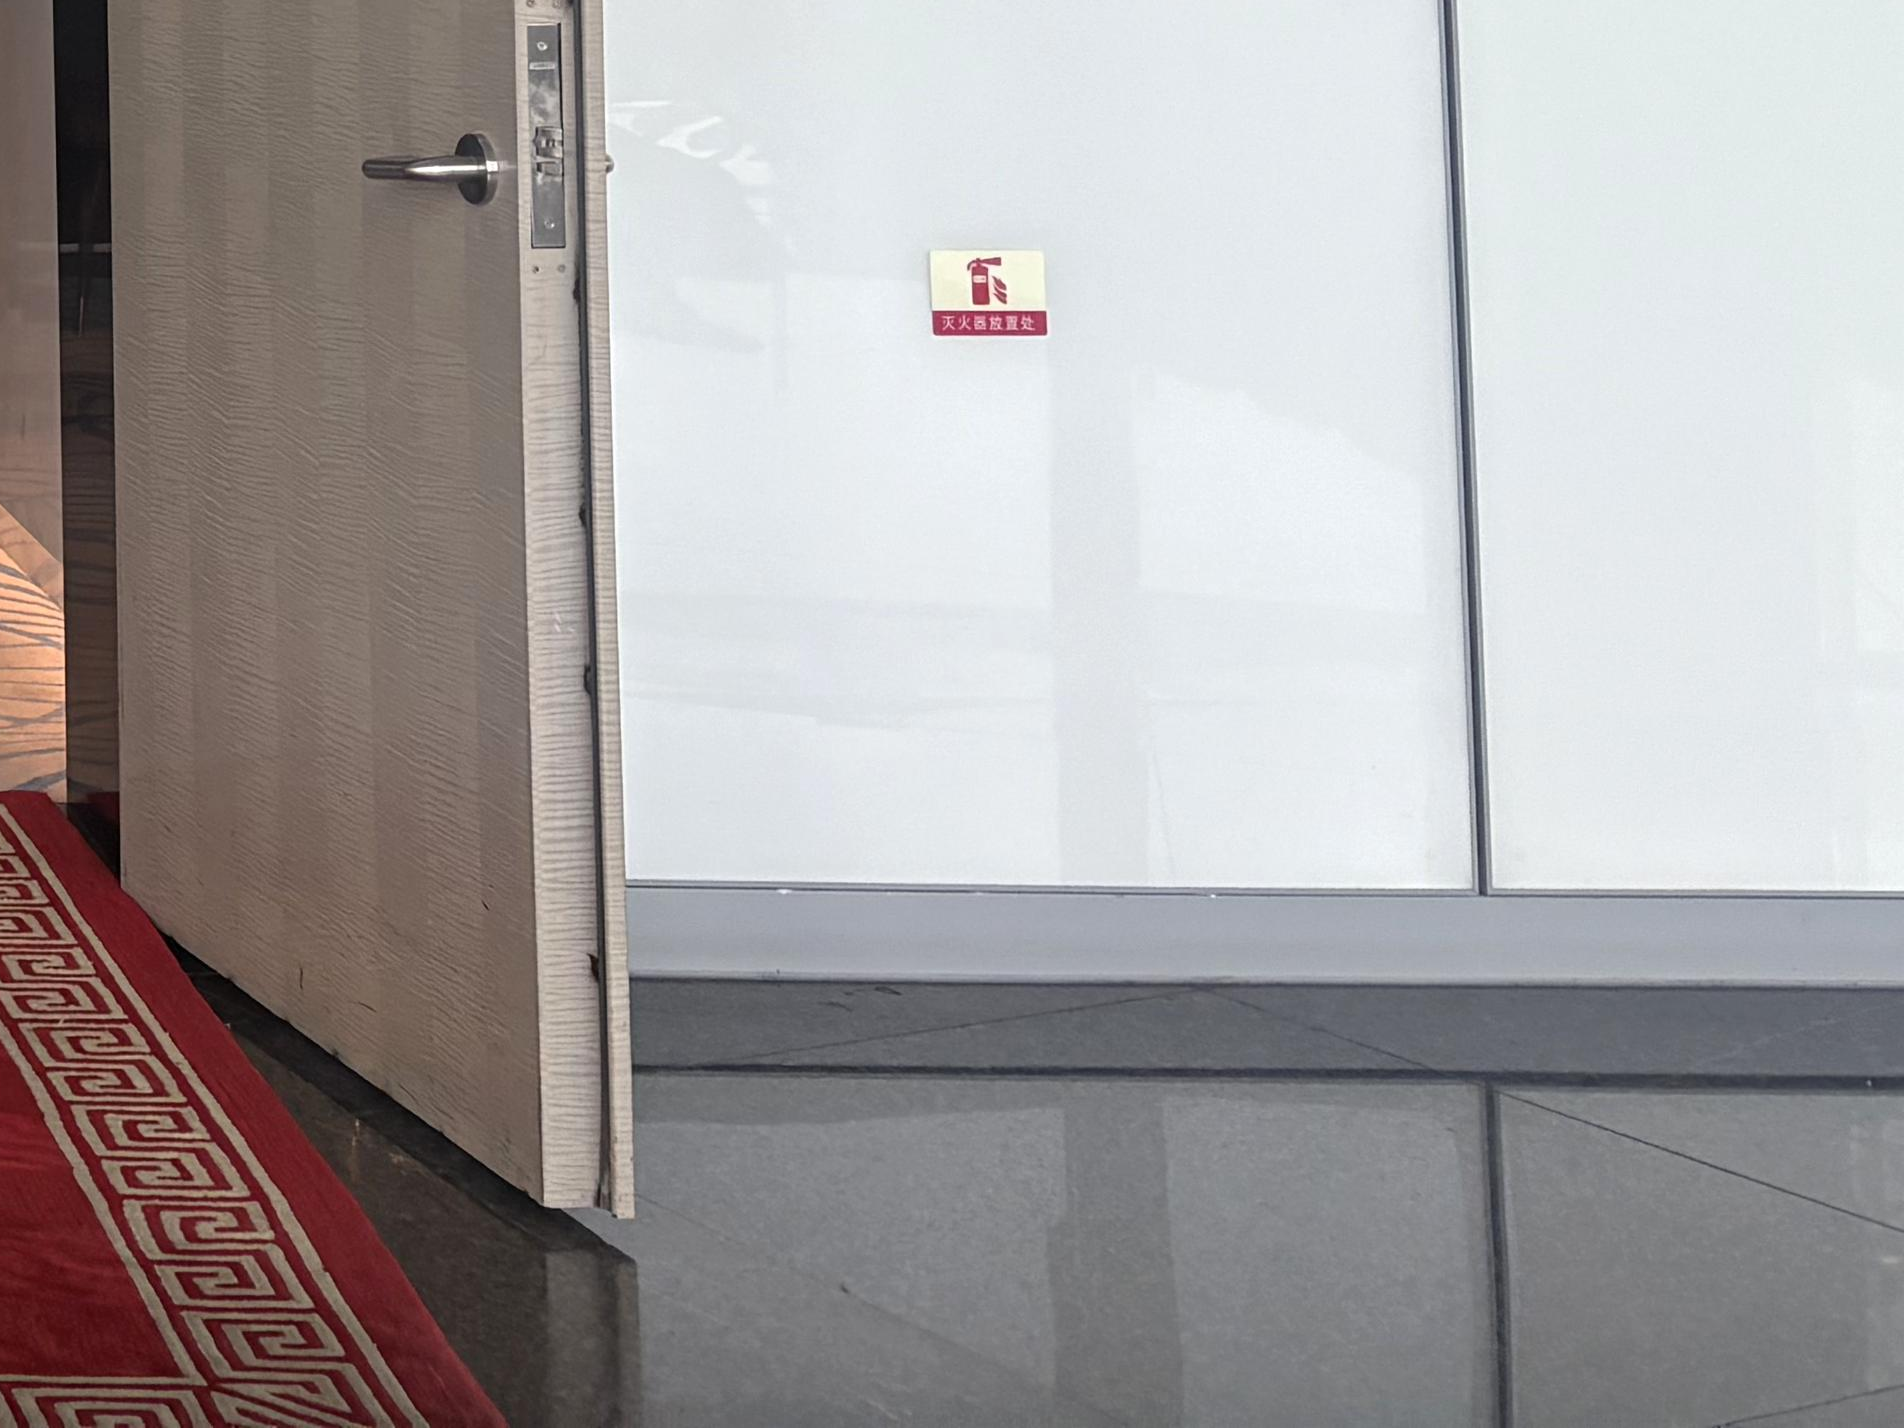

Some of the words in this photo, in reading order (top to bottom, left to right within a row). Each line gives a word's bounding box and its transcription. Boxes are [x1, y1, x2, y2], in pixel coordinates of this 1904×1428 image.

[942, 315, 1035, 331] 灭火器放置处
